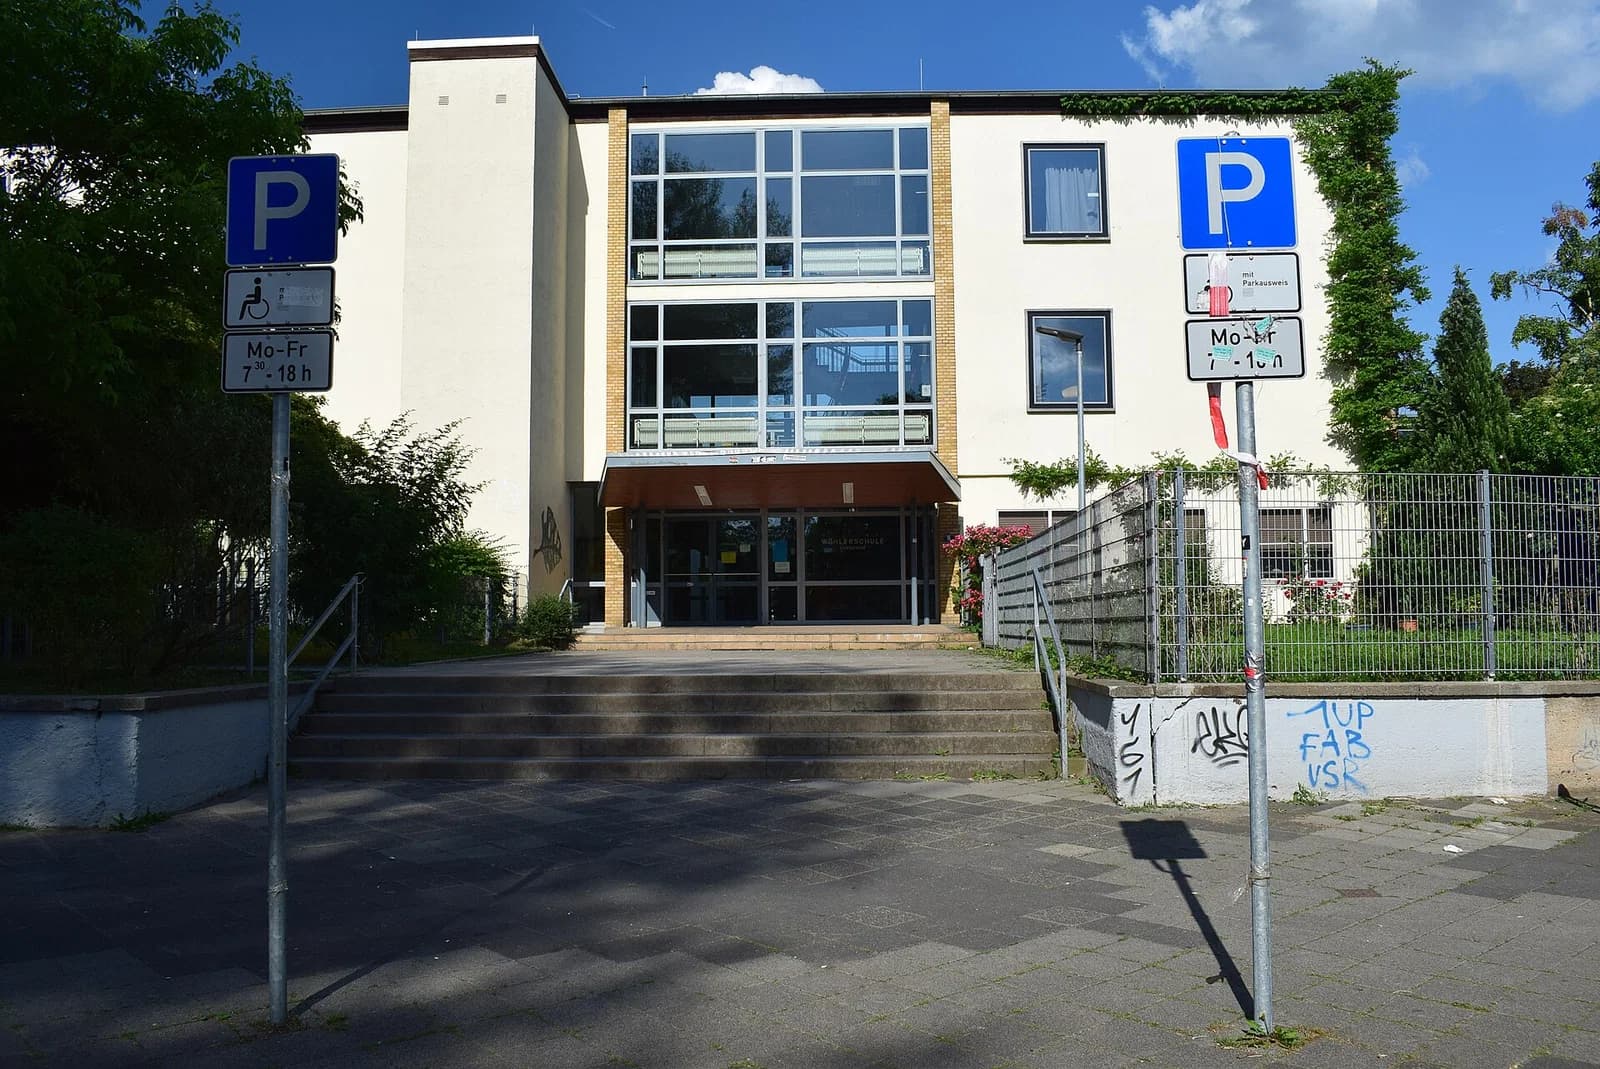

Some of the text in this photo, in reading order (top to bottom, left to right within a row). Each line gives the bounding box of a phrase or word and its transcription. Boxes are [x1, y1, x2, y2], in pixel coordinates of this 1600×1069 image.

[1205, 152, 1266, 235] P
[254, 171, 311, 250] P
[1242, 271, 1254, 279] mit
[1242, 279, 1289, 287] Parkausweis
[247, 341, 308, 360] Mo-Fr
[1287, 700, 1374, 729] 1UP
[1300, 729, 1371, 761] FAB
[1308, 758, 1368, 793] VSR
